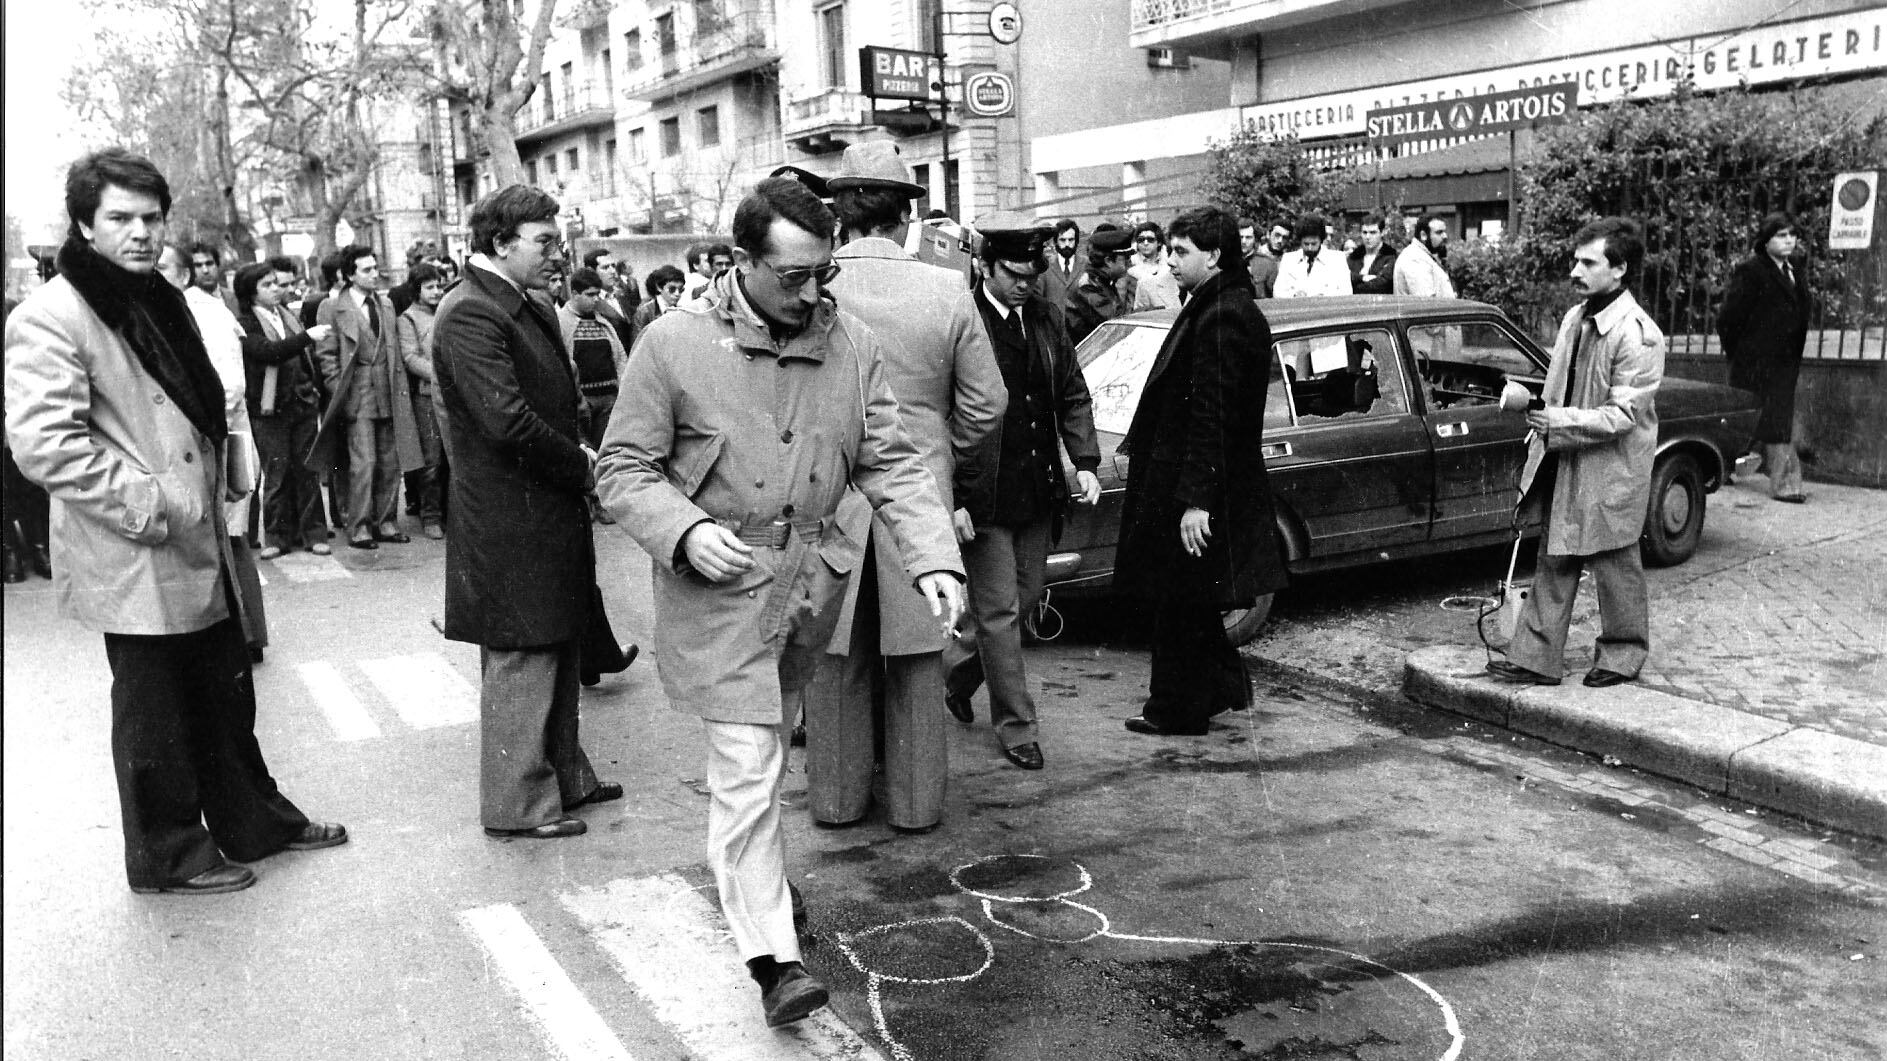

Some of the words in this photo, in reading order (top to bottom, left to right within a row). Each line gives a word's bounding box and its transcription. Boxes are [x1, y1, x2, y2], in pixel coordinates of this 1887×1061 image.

[876, 53, 923, 77] BAR
[1248, 104, 1354, 132] PASTICCERIA
[1704, 25, 1880, 74] GELATERI
[1368, 110, 1443, 138] STELLA
[1480, 92, 1566, 125] ARTOIS
